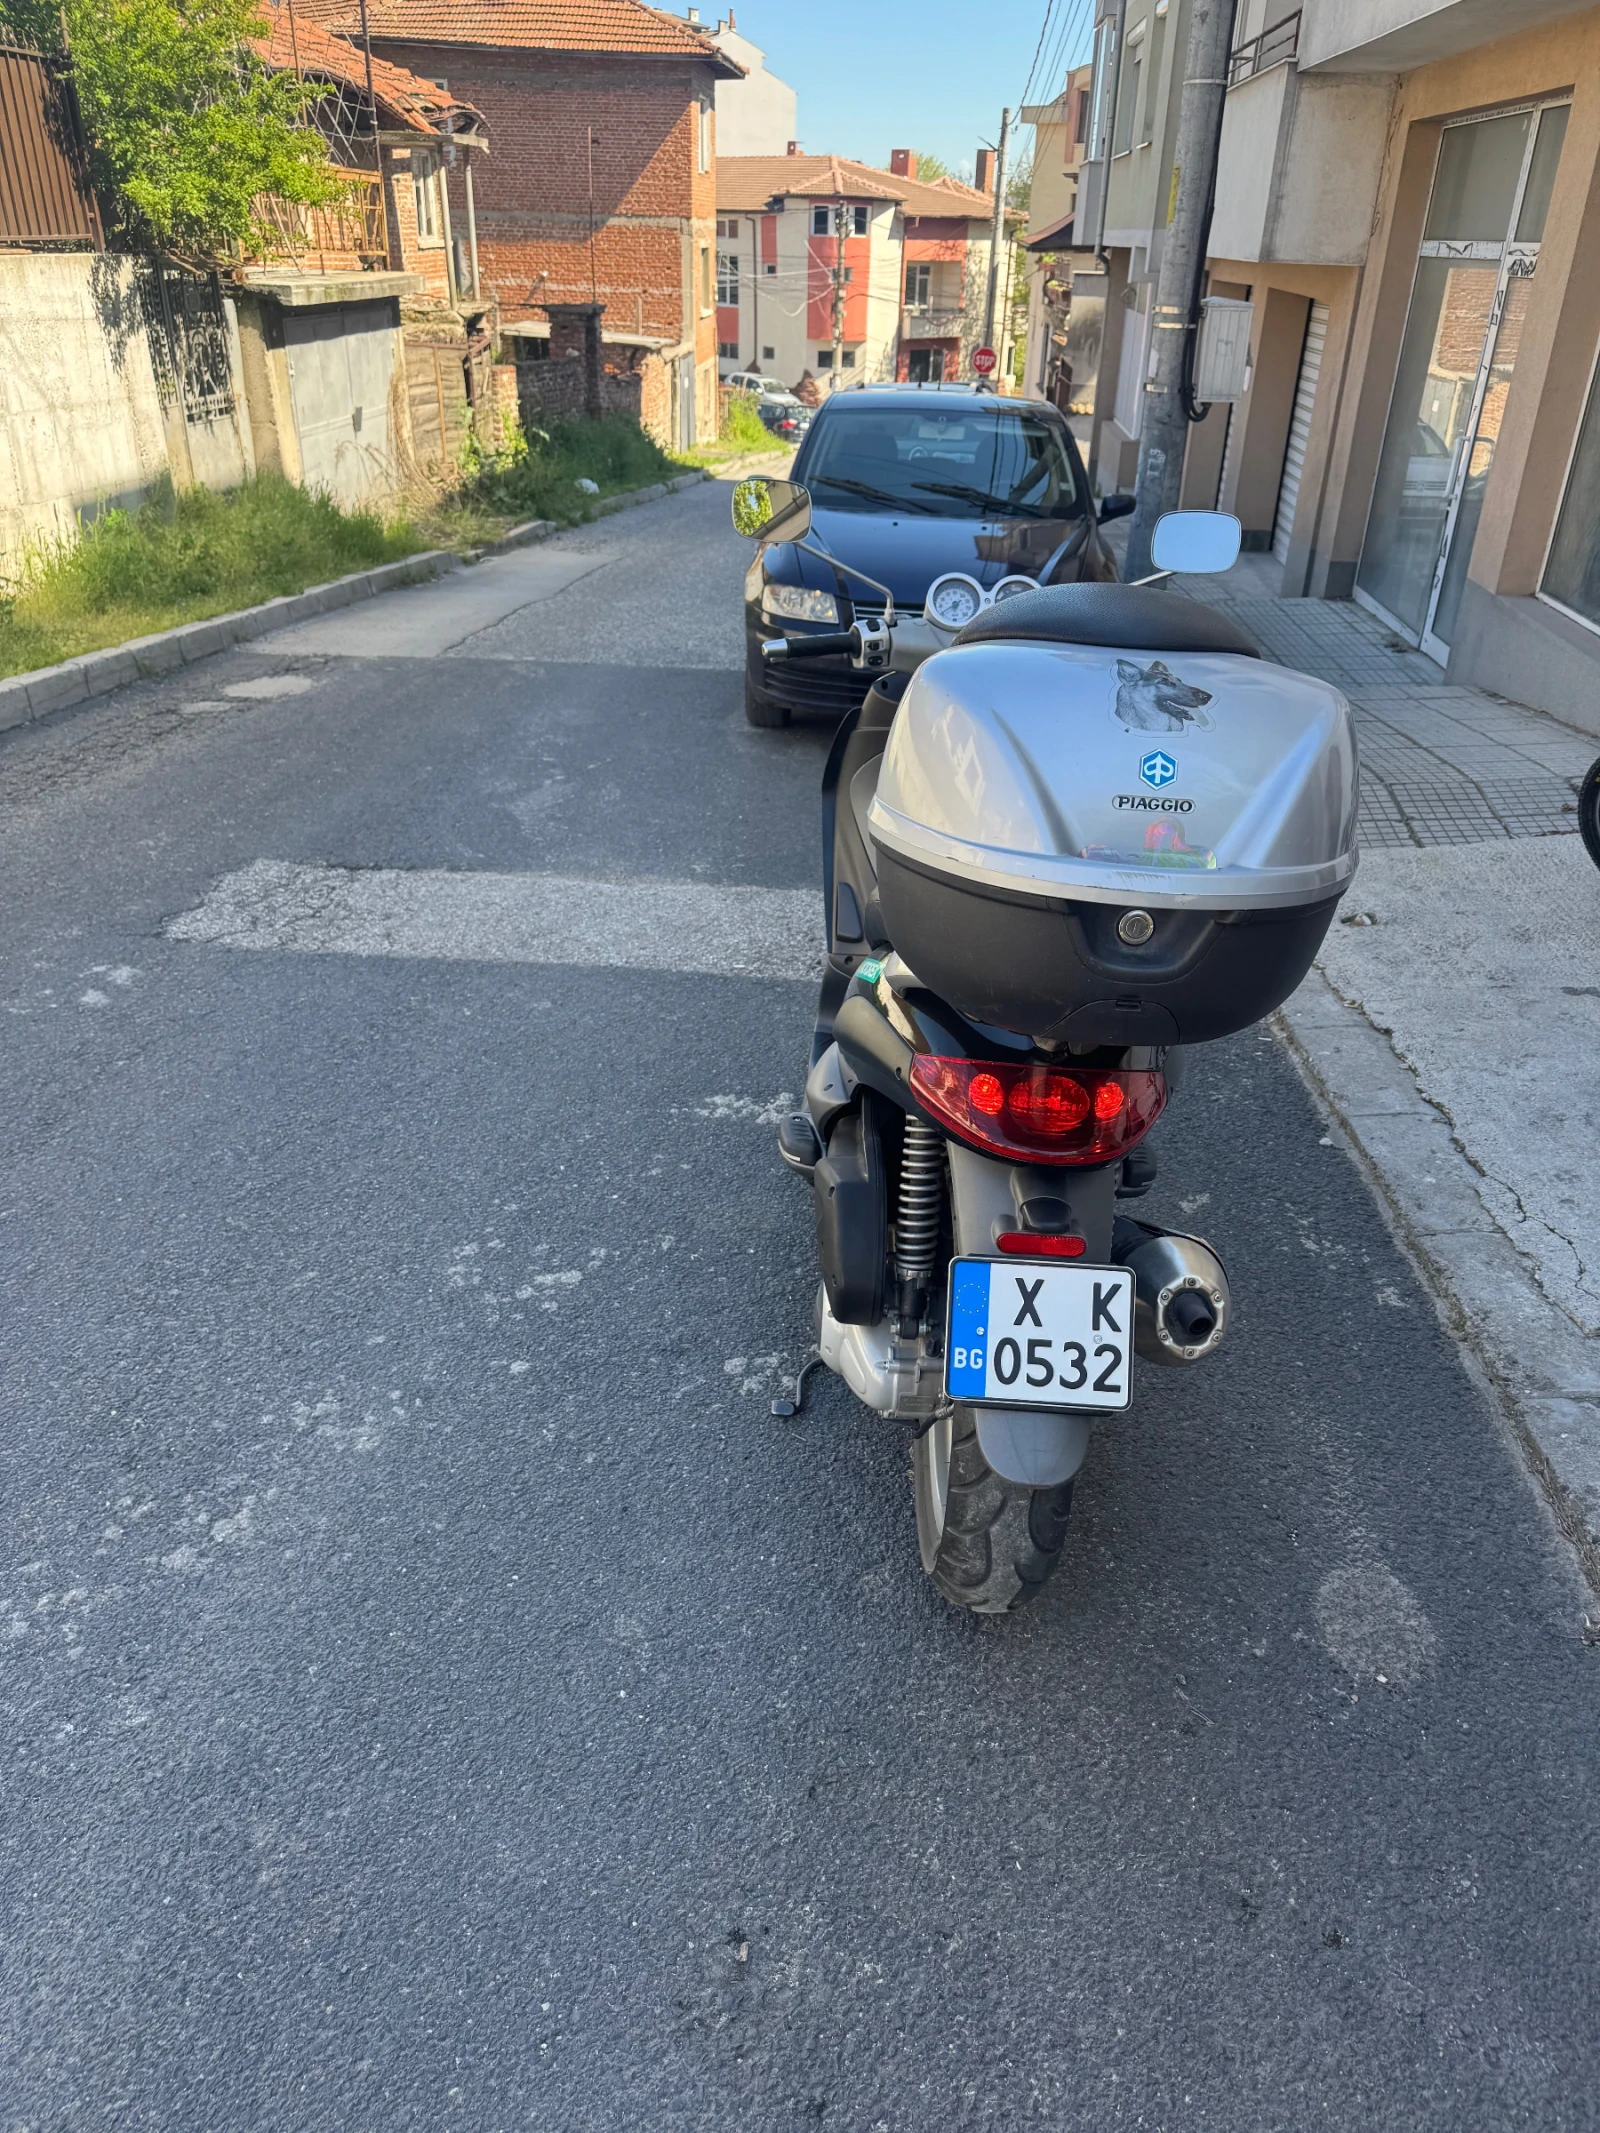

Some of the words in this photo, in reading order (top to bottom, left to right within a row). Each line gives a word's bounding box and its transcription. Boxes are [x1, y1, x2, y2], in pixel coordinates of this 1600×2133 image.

[975, 354, 995, 368] STOP
[1117, 796, 1193, 812] PIAGGIO
[1013, 1277, 1045, 1327] X
[1091, 1282, 1123, 1332] K
[953, 1347, 983, 1370] BG
[993, 1336, 1123, 1393] 0532
